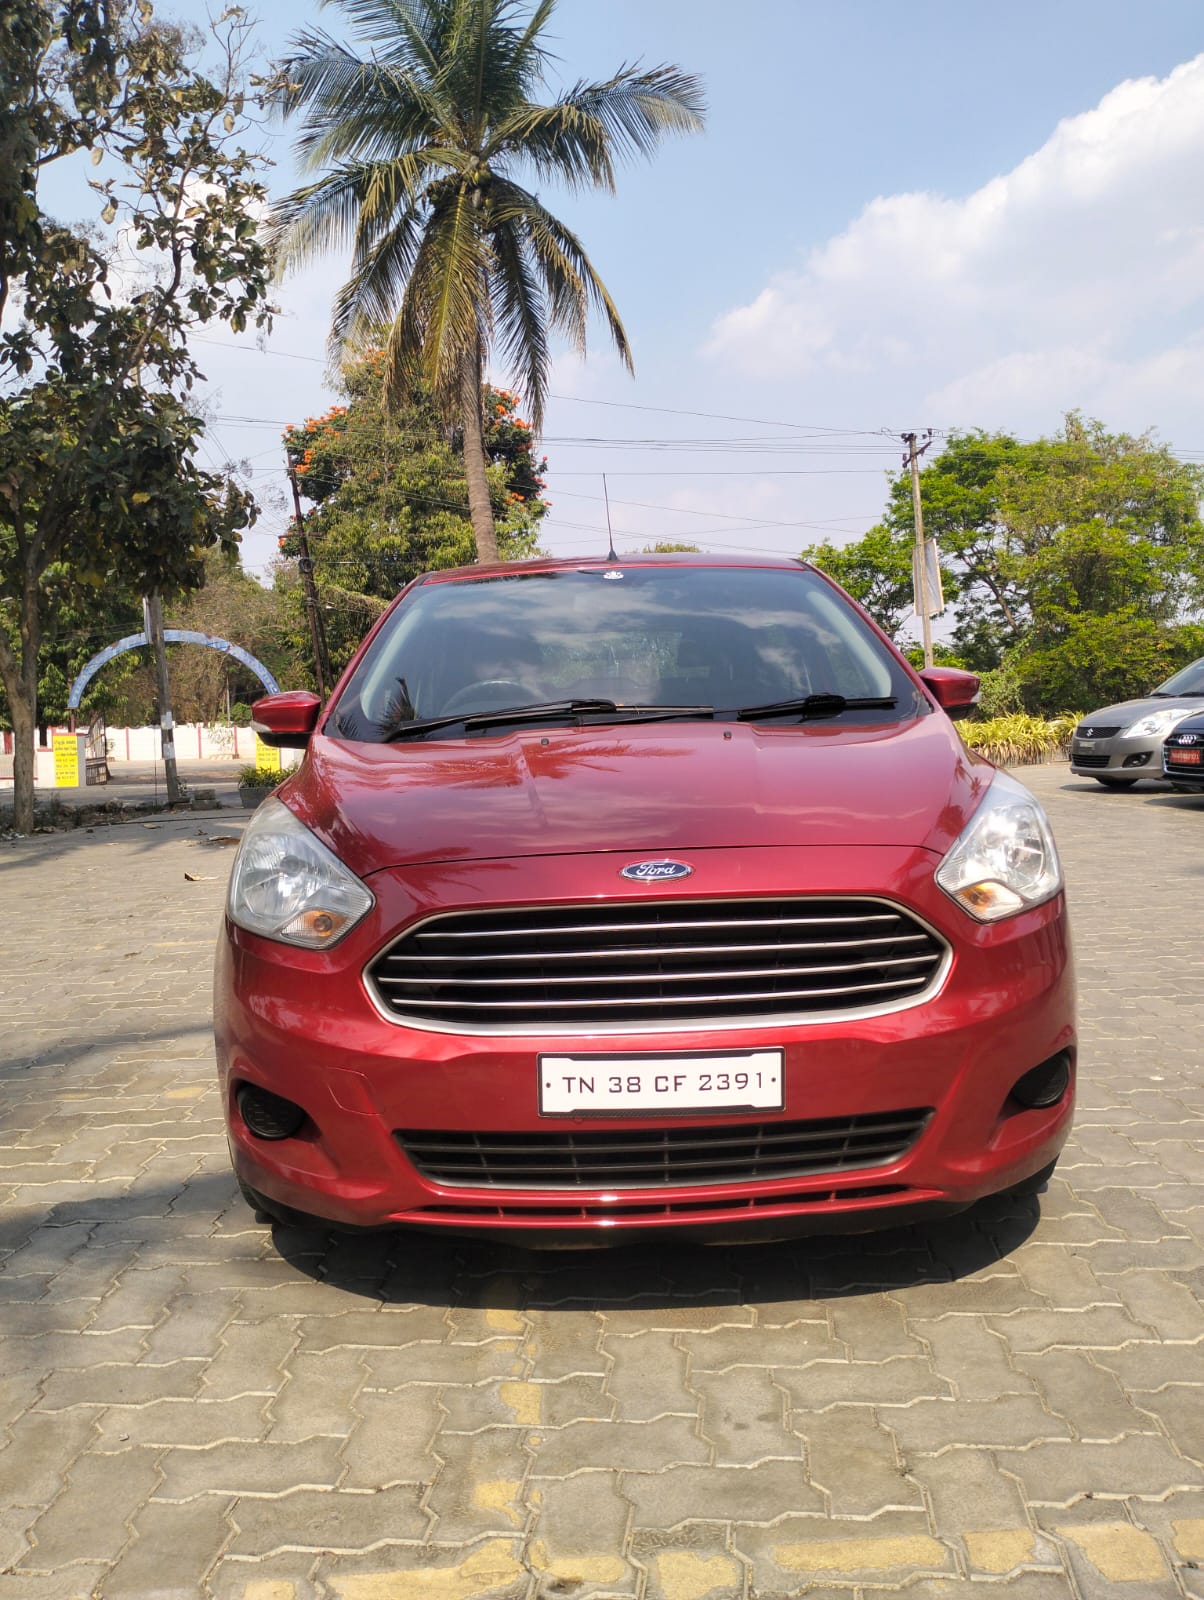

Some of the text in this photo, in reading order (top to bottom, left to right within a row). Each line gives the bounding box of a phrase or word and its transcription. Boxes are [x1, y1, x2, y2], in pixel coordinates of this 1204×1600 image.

[636, 863, 676, 875] Ford
[562, 1072, 762, 1093] TN 38 CF 2391
